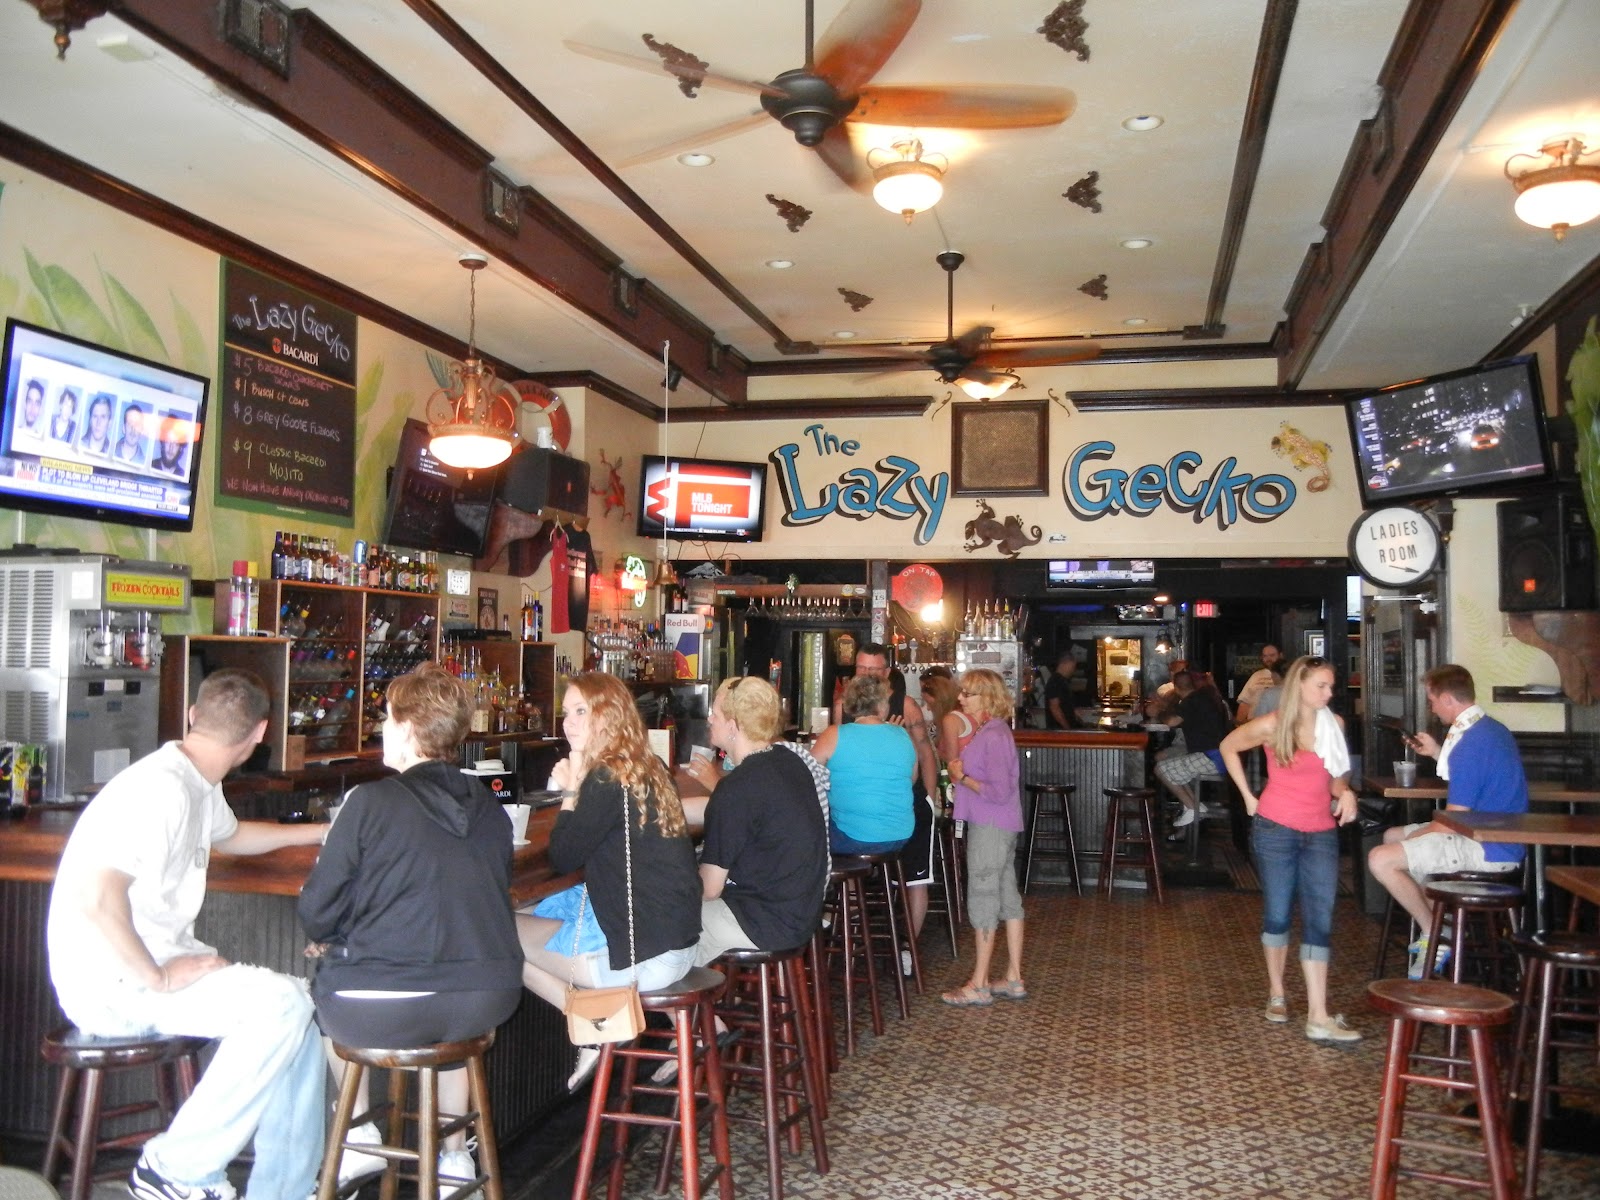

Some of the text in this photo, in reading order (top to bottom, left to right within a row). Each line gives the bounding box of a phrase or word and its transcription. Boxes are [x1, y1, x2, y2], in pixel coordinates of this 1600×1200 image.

[249, 295, 297, 341] Lazy
[691, 492, 713, 504] MLB
[768, 442, 950, 546] Lazy
[691, 503, 733, 515] TONIGHT
[1370, 520, 1419, 541] LADIES
[1379, 544, 1418, 564] ROOM
[902, 566, 936, 577] ON TAP
[111, 582, 180, 598] FROZEN COCKTAILS
[1196, 603, 1213, 617] EXIT
[666, 618, 698, 628] Red Bull
[494, 790, 511, 798] ARDI
